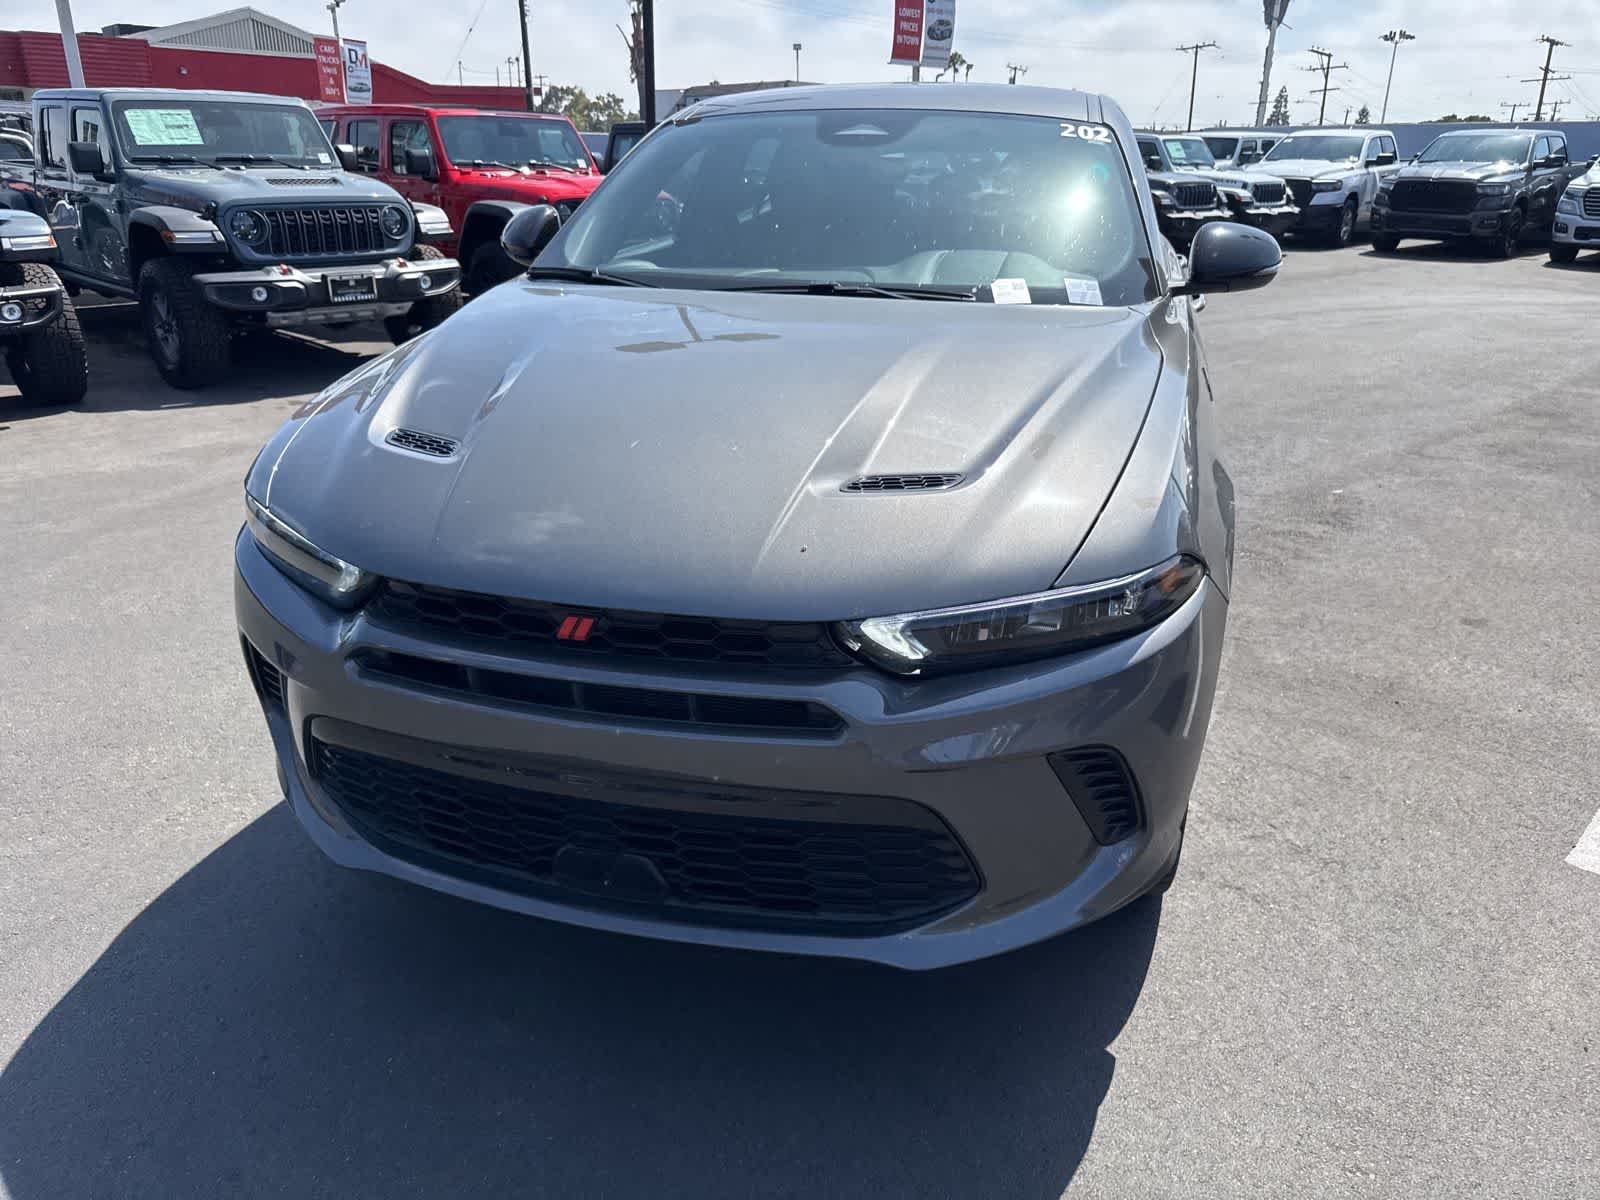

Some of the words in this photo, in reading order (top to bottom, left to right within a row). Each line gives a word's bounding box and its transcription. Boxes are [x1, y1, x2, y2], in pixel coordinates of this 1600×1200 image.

[898, 7, 920, 18] LOWEST
[900, 21, 918, 32] PRICES
[896, 34, 903, 45] IN
[903, 35, 920, 46] TOWN
[319, 44, 336, 54] CARS
[318, 55, 340, 65] TRUCKS
[1059, 123, 1112, 143] 202
